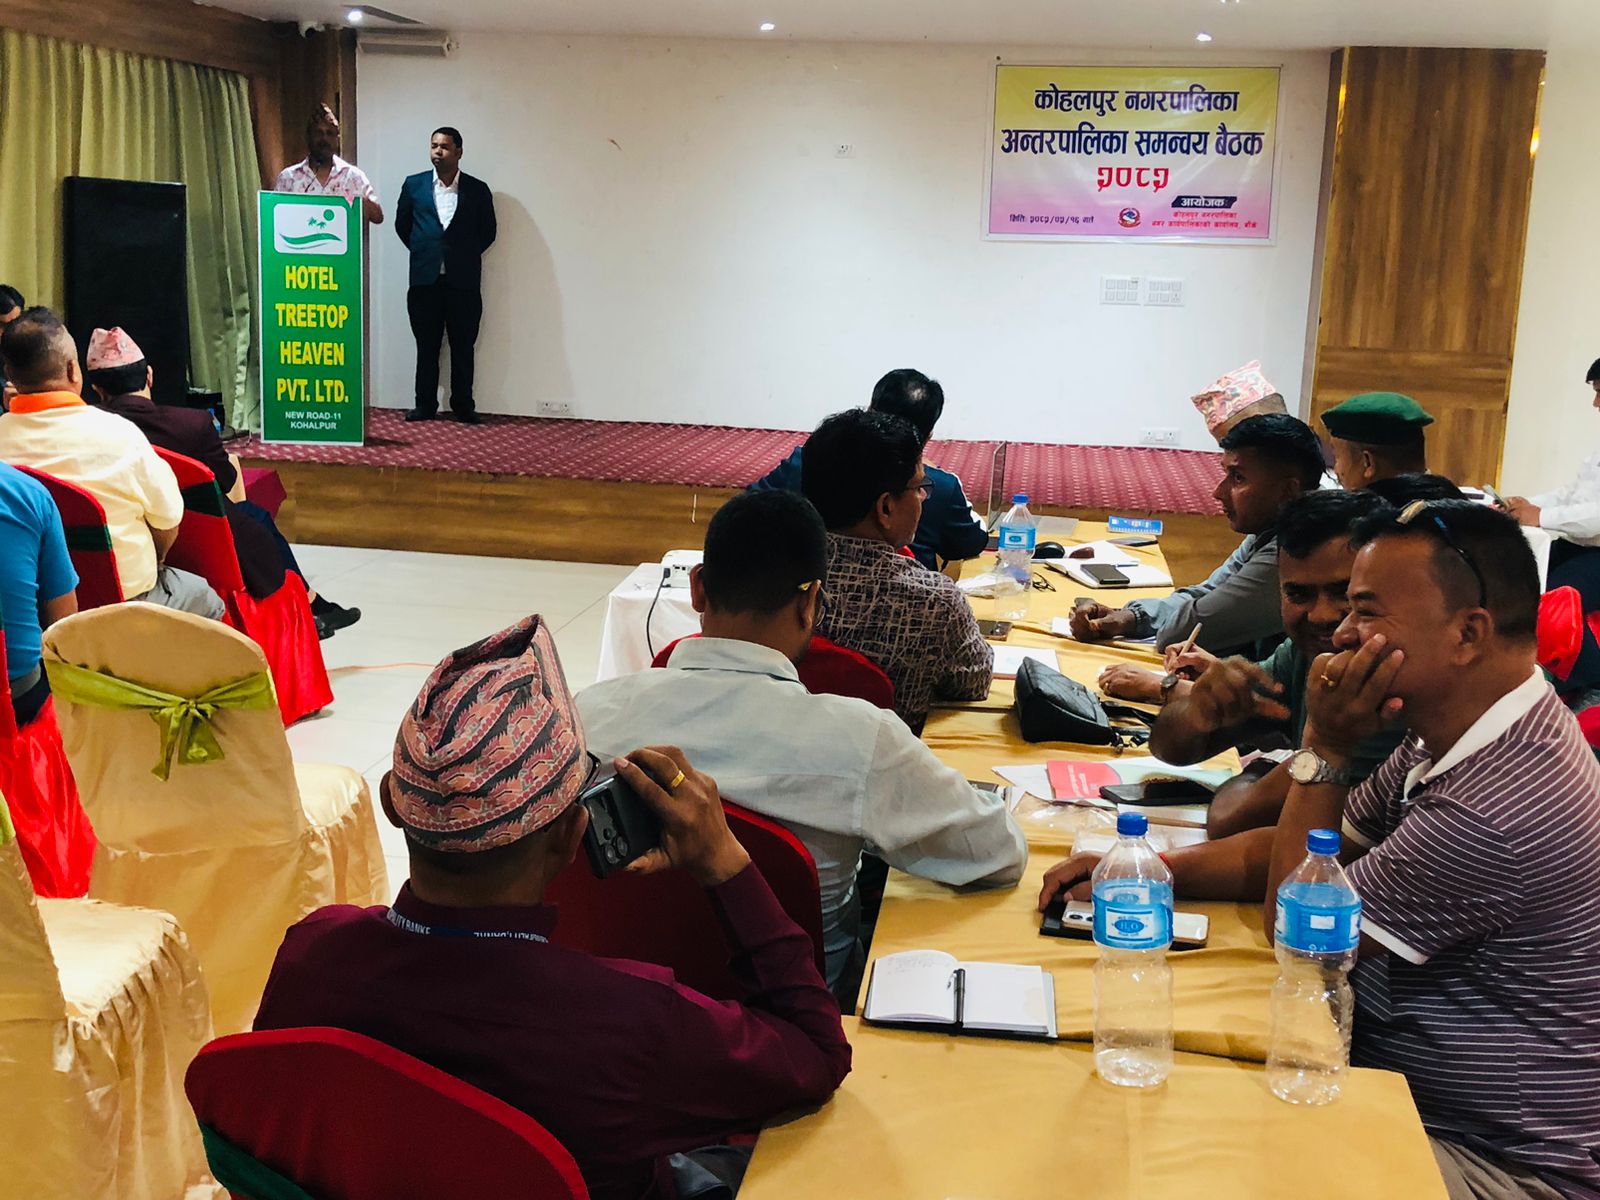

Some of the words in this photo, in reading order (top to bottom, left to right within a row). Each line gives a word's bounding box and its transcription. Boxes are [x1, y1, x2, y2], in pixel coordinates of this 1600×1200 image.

[1034, 83, 1119, 116] कोहलपुर
[1125, 84, 1240, 112] नगरपालिका
[1001, 121, 1129, 155] अन्तरपालिका
[1135, 130, 1210, 156] समन्वय
[1216, 122, 1265, 156] बैठक
[1097, 167, 1169, 192] २०८२
[285, 265, 338, 291] HOTEL
[275, 303, 349, 329] TREETOP
[280, 341, 345, 366] HEAVEN
[276, 378, 311, 403] PVT.
[315, 379, 349, 404] LTD.
[285, 411, 304, 419] NEW
[306, 411, 341, 420] ROAD-11
[290, 421, 337, 430] KOHALPUR
